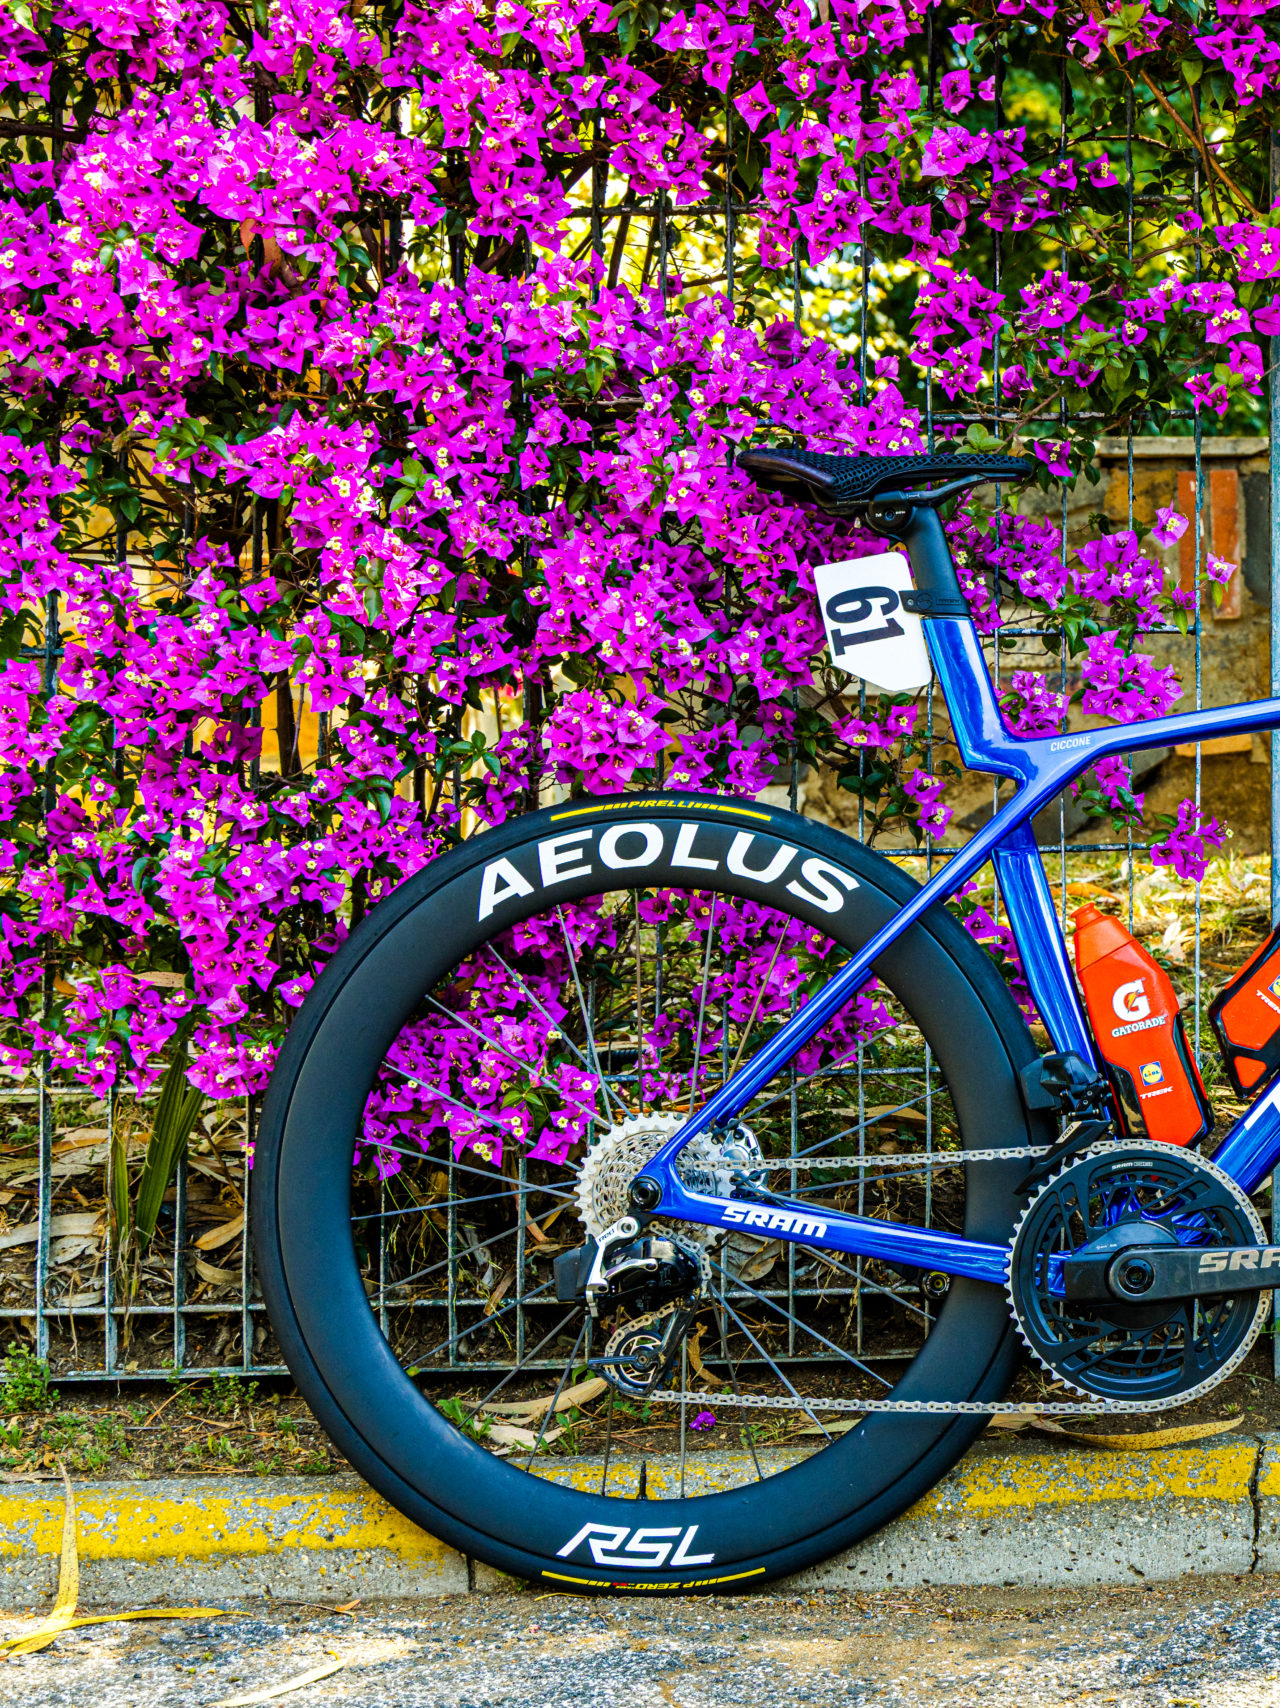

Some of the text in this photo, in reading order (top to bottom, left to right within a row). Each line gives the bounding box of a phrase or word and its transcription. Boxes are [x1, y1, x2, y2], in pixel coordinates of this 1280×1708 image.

[826, 586, 905, 656] 61
[1050, 736, 1092, 751] CICCONE
[628, 800, 694, 808] PIRELLI
[478, 822, 860, 922] AEOLUS
[1112, 979, 1151, 1022] G
[1111, 1016, 1166, 1038] GATORADE
[721, 1206, 828, 1238] SRAM
[556, 1522, 715, 1567] RSL
[635, 1582, 681, 1590] ZERO
